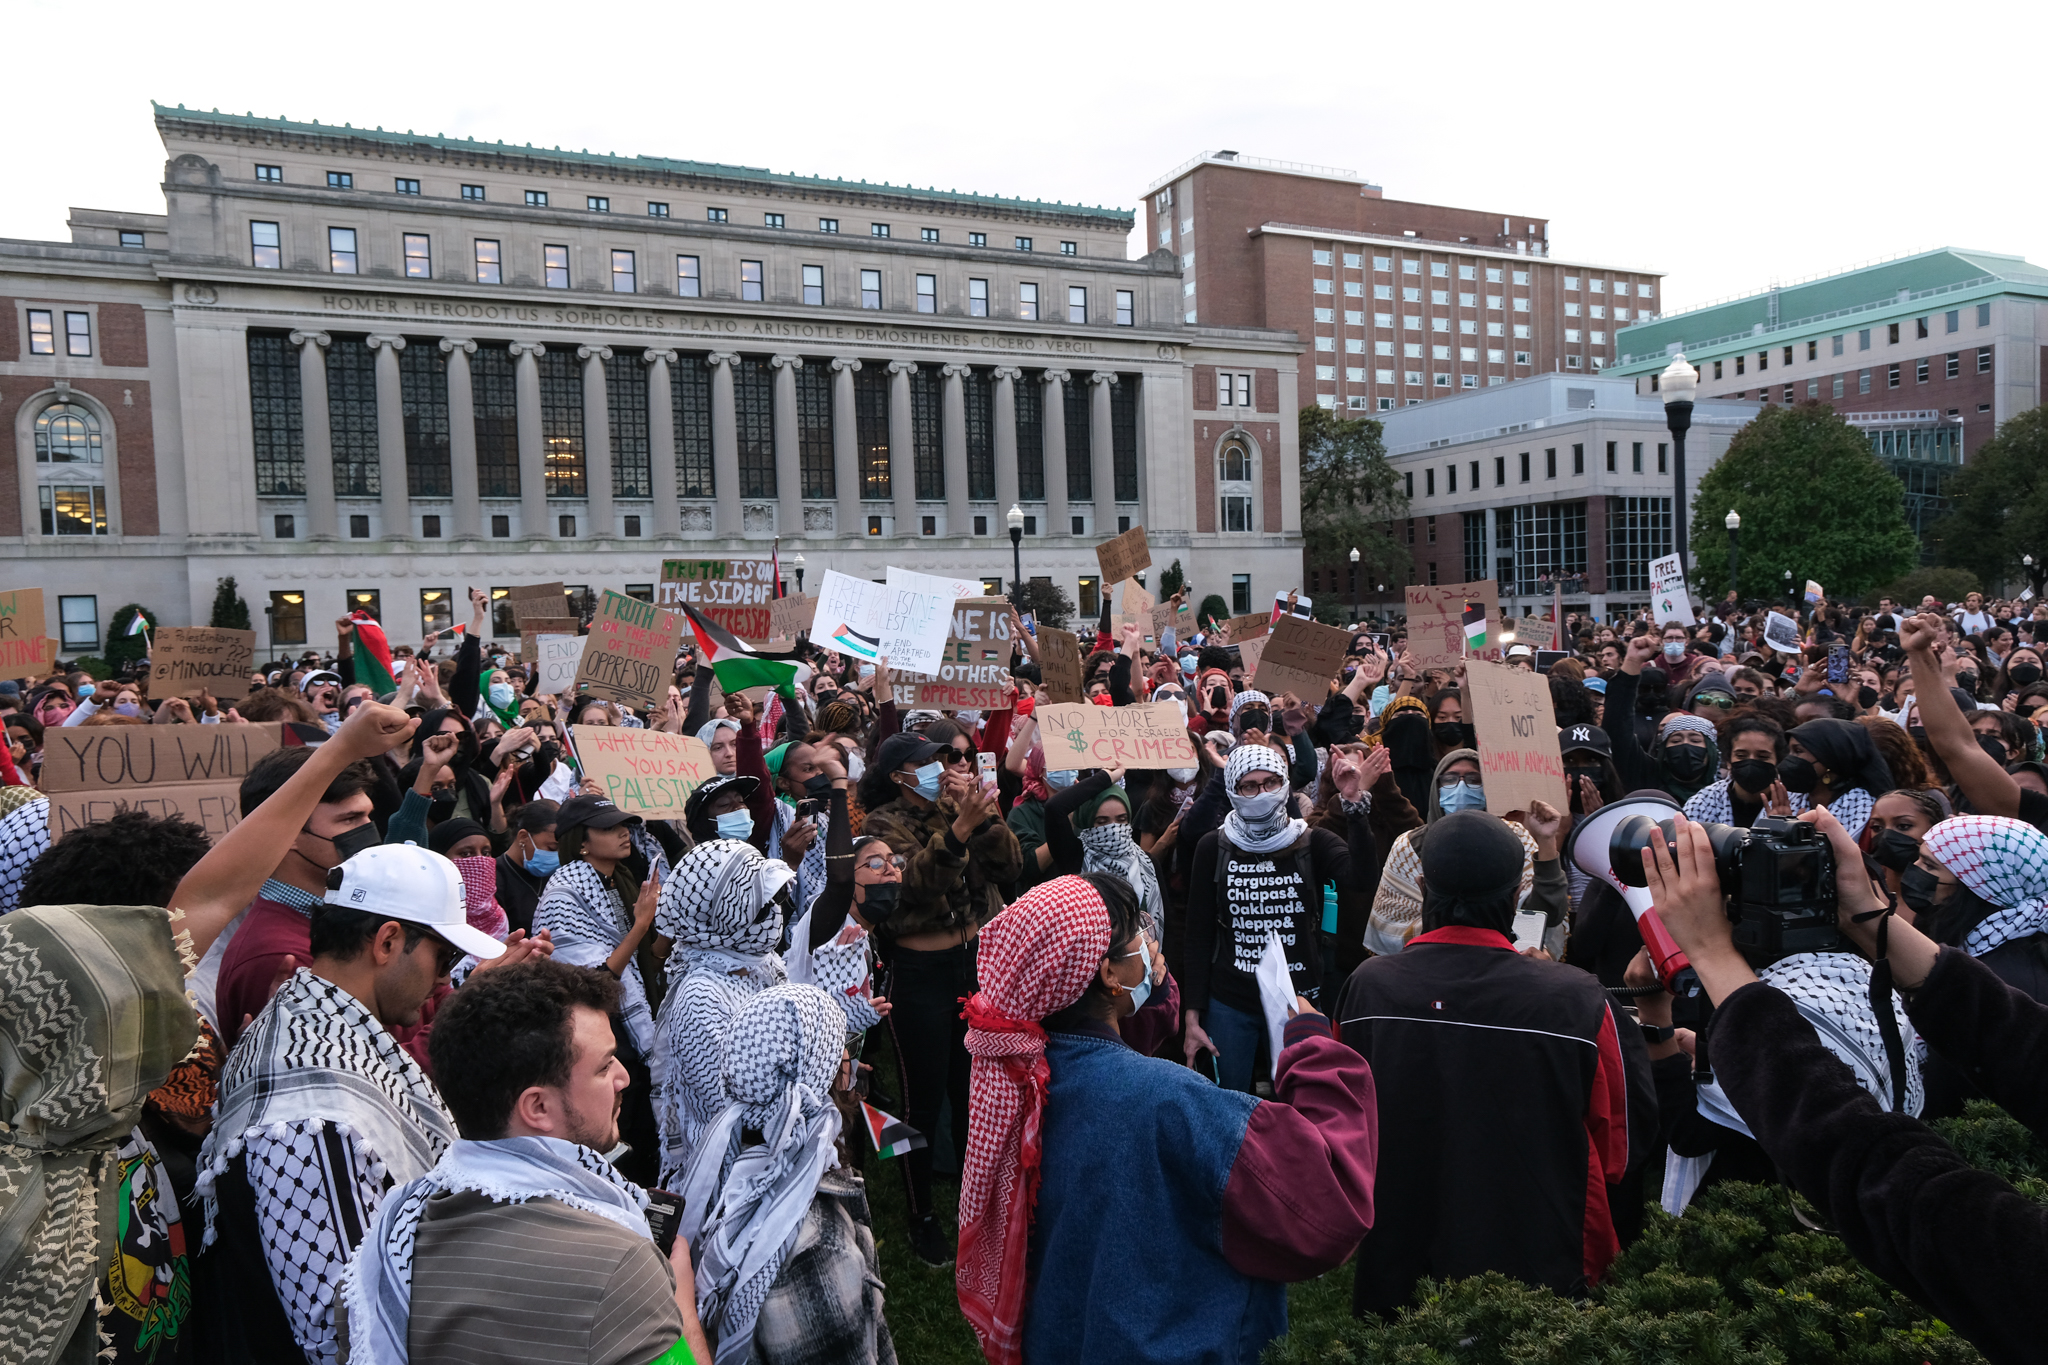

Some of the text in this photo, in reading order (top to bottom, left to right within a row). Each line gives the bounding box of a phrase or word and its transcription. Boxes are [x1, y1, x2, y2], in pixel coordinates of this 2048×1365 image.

[322, 294, 1097, 354] HOMER HERODOTUS SOPHOCLES PLATO ARISTOTLE DEMOSTHENES CICERO VERGIL
[664, 560, 775, 582] TRUTH IS ON
[1654, 560, 1677, 579] FREE
[660, 581, 702, 604] THE
[830, 575, 942, 621] FREE PALESTINE
[604, 589, 658, 630] TRUTH
[662, 614, 676, 632] IS
[827, 598, 928, 637] FREE PALESTINE
[156, 629, 241, 644] Do Palestinians
[601, 620, 672, 650] ON THE SIDE
[988, 611, 1010, 641] IS
[894, 638, 912, 648] END
[1288, 622, 1309, 644] TO
[1310, 631, 1350, 653] EXIST
[160, 643, 252, 663] not matter ???
[547, 641, 580, 660] END
[607, 638, 653, 660] OF THE
[891, 646, 931, 659] APARTHEID
[1056, 638, 1074, 663] US
[1413, 653, 1450, 667] Since
[586, 650, 661, 695] OPPRESSED
[940, 664, 1010, 686] OTHERS
[1287, 665, 1328, 688] RESIST
[920, 684, 1013, 709] OPPRESSED
[1485, 678, 1543, 712] We are
[1047, 710, 1159, 732] NO MORE
[1511, 714, 1535, 738] NOT
[594, 731, 689, 753] WHY CAN'T
[1098, 729, 1130, 738] FOR
[1137, 728, 1181, 738] ISRAEL'S
[1571, 726, 1591, 742] NY
[63, 733, 156, 785] YOU
[177, 733, 250, 781] WILL
[1092, 737, 1195, 762] CRIMES
[624, 756, 700, 780] YOU SAY
[606, 774, 705, 810] PALESTIN
[1226, 872, 1304, 889] Ferguson&
[1226, 886, 1300, 903] Chiapas&
[1228, 900, 1306, 916] Oakland&
[1231, 915, 1295, 933] Aleppo&
[1233, 930, 1297, 947] Standng
[1233, 958, 1307, 974] Minao.
